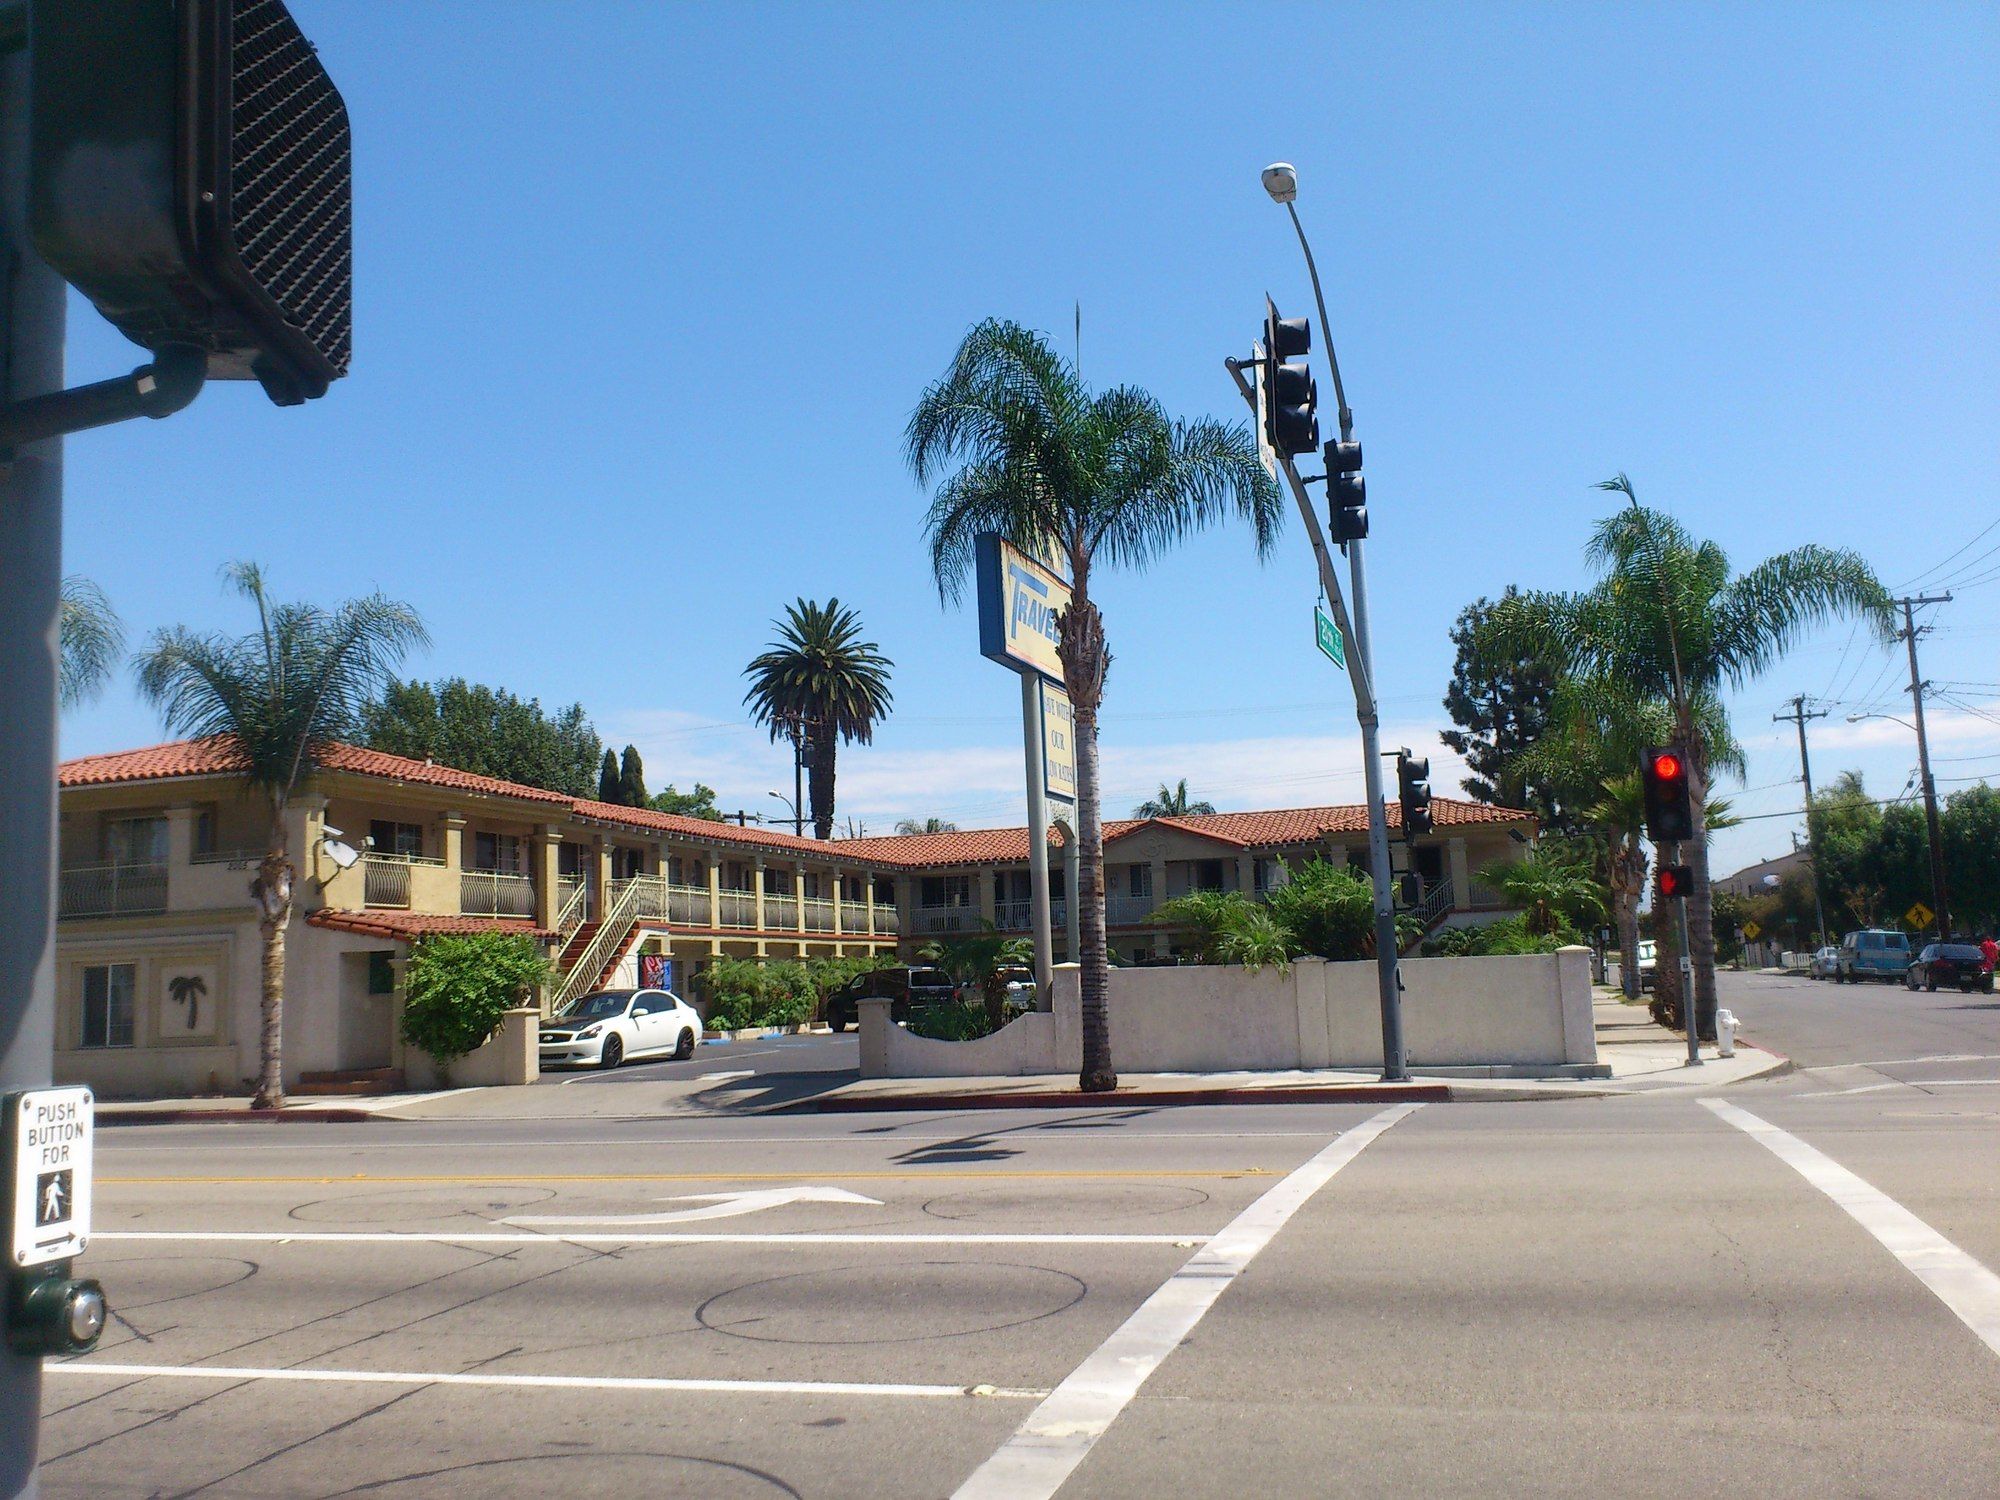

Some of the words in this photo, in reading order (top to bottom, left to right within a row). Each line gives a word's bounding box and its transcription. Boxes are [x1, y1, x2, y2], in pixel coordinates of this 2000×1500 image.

[1051, 729, 1065, 751] OUR
[38, 1102, 76, 1123] PUSH
[28, 1121, 84, 1146] BUTTON
[42, 1145, 69, 1165] FOR
